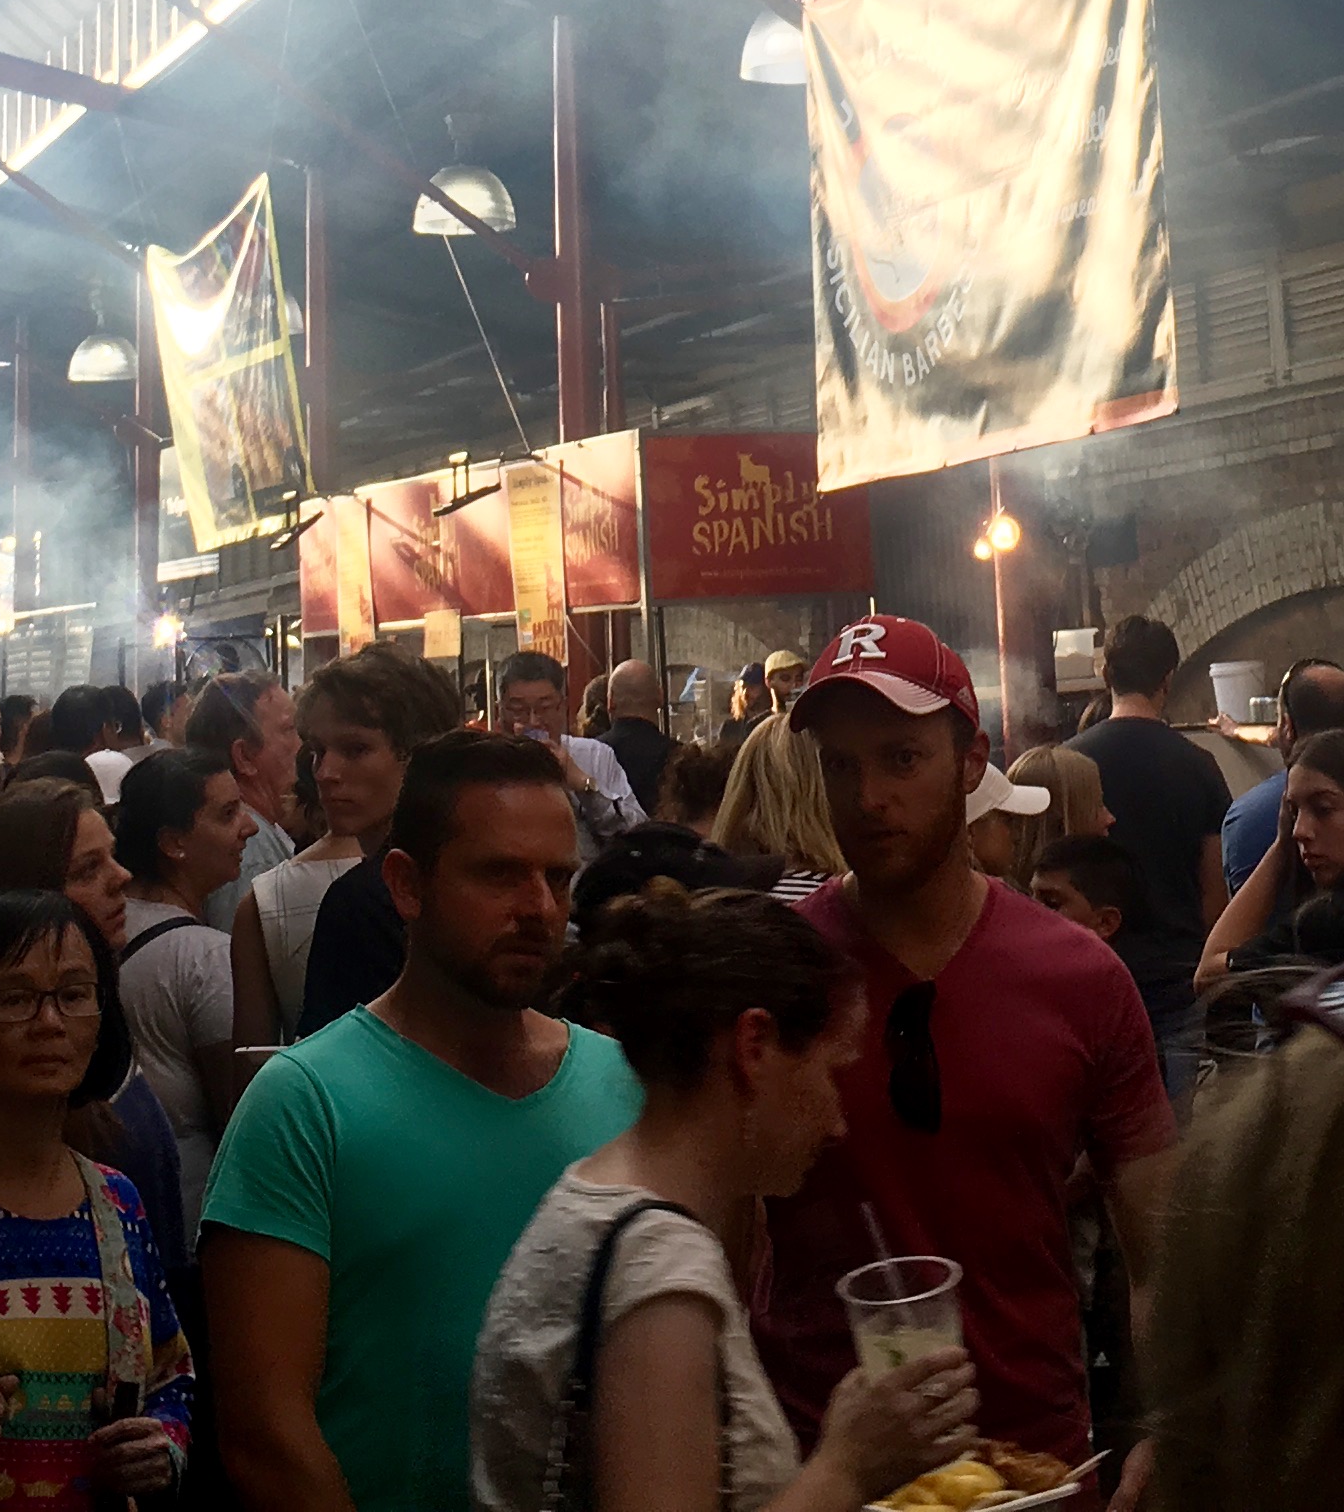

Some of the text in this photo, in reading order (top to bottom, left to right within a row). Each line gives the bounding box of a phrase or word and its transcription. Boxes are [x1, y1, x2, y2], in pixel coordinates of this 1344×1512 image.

[827, 243, 895, 384] SICILIAN
[694, 470, 819, 515] Simply
[692, 507, 833, 556] SPANISH
[832, 624, 887, 666] R
